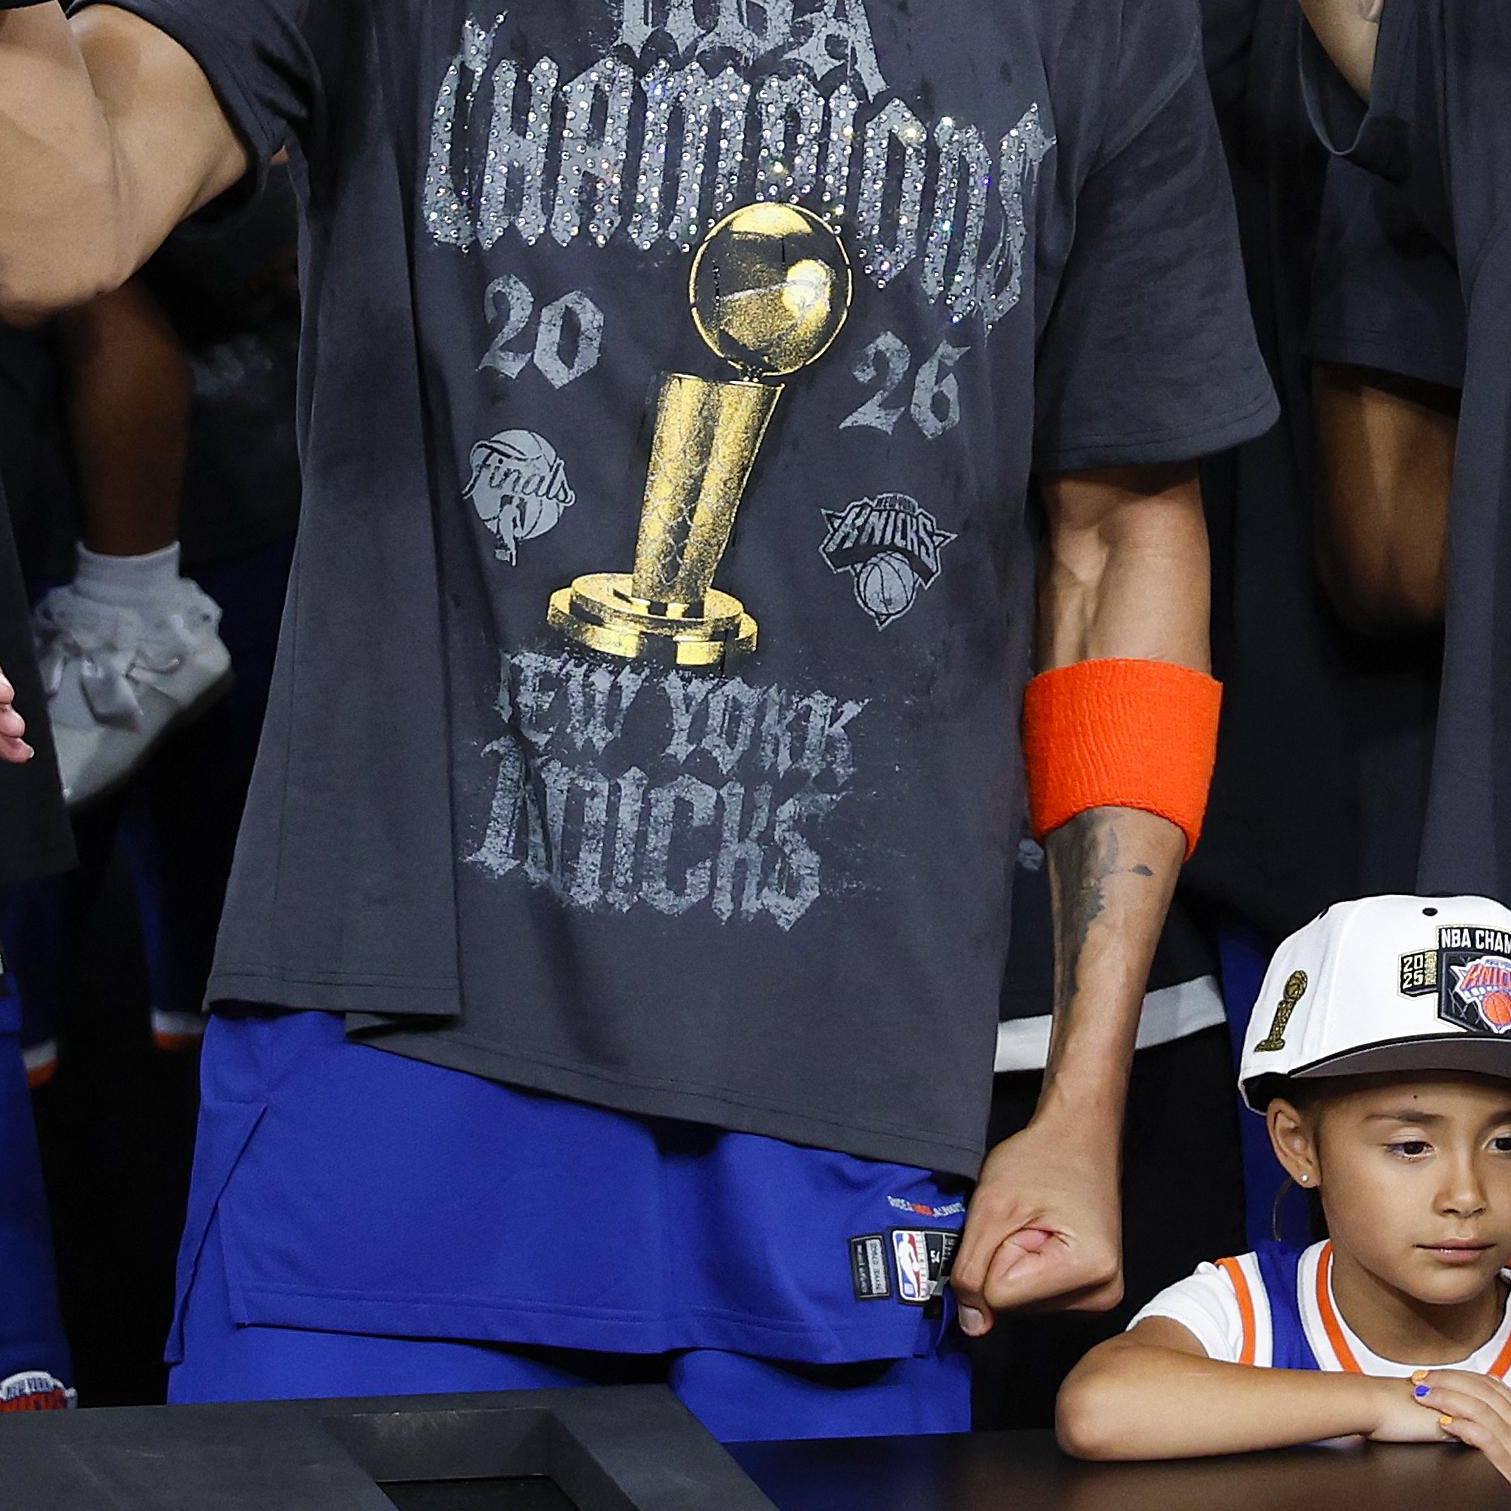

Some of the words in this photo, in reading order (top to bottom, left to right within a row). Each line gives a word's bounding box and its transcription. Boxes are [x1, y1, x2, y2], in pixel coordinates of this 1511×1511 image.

[475, 274, 606, 390] 20
[838, 330, 970, 441] 26
[827, 505, 938, 566] KNICKS
[1440, 927, 1473, 949] NBA
[1403, 953, 1424, 971] 20
[1402, 969, 1425, 988] 25
